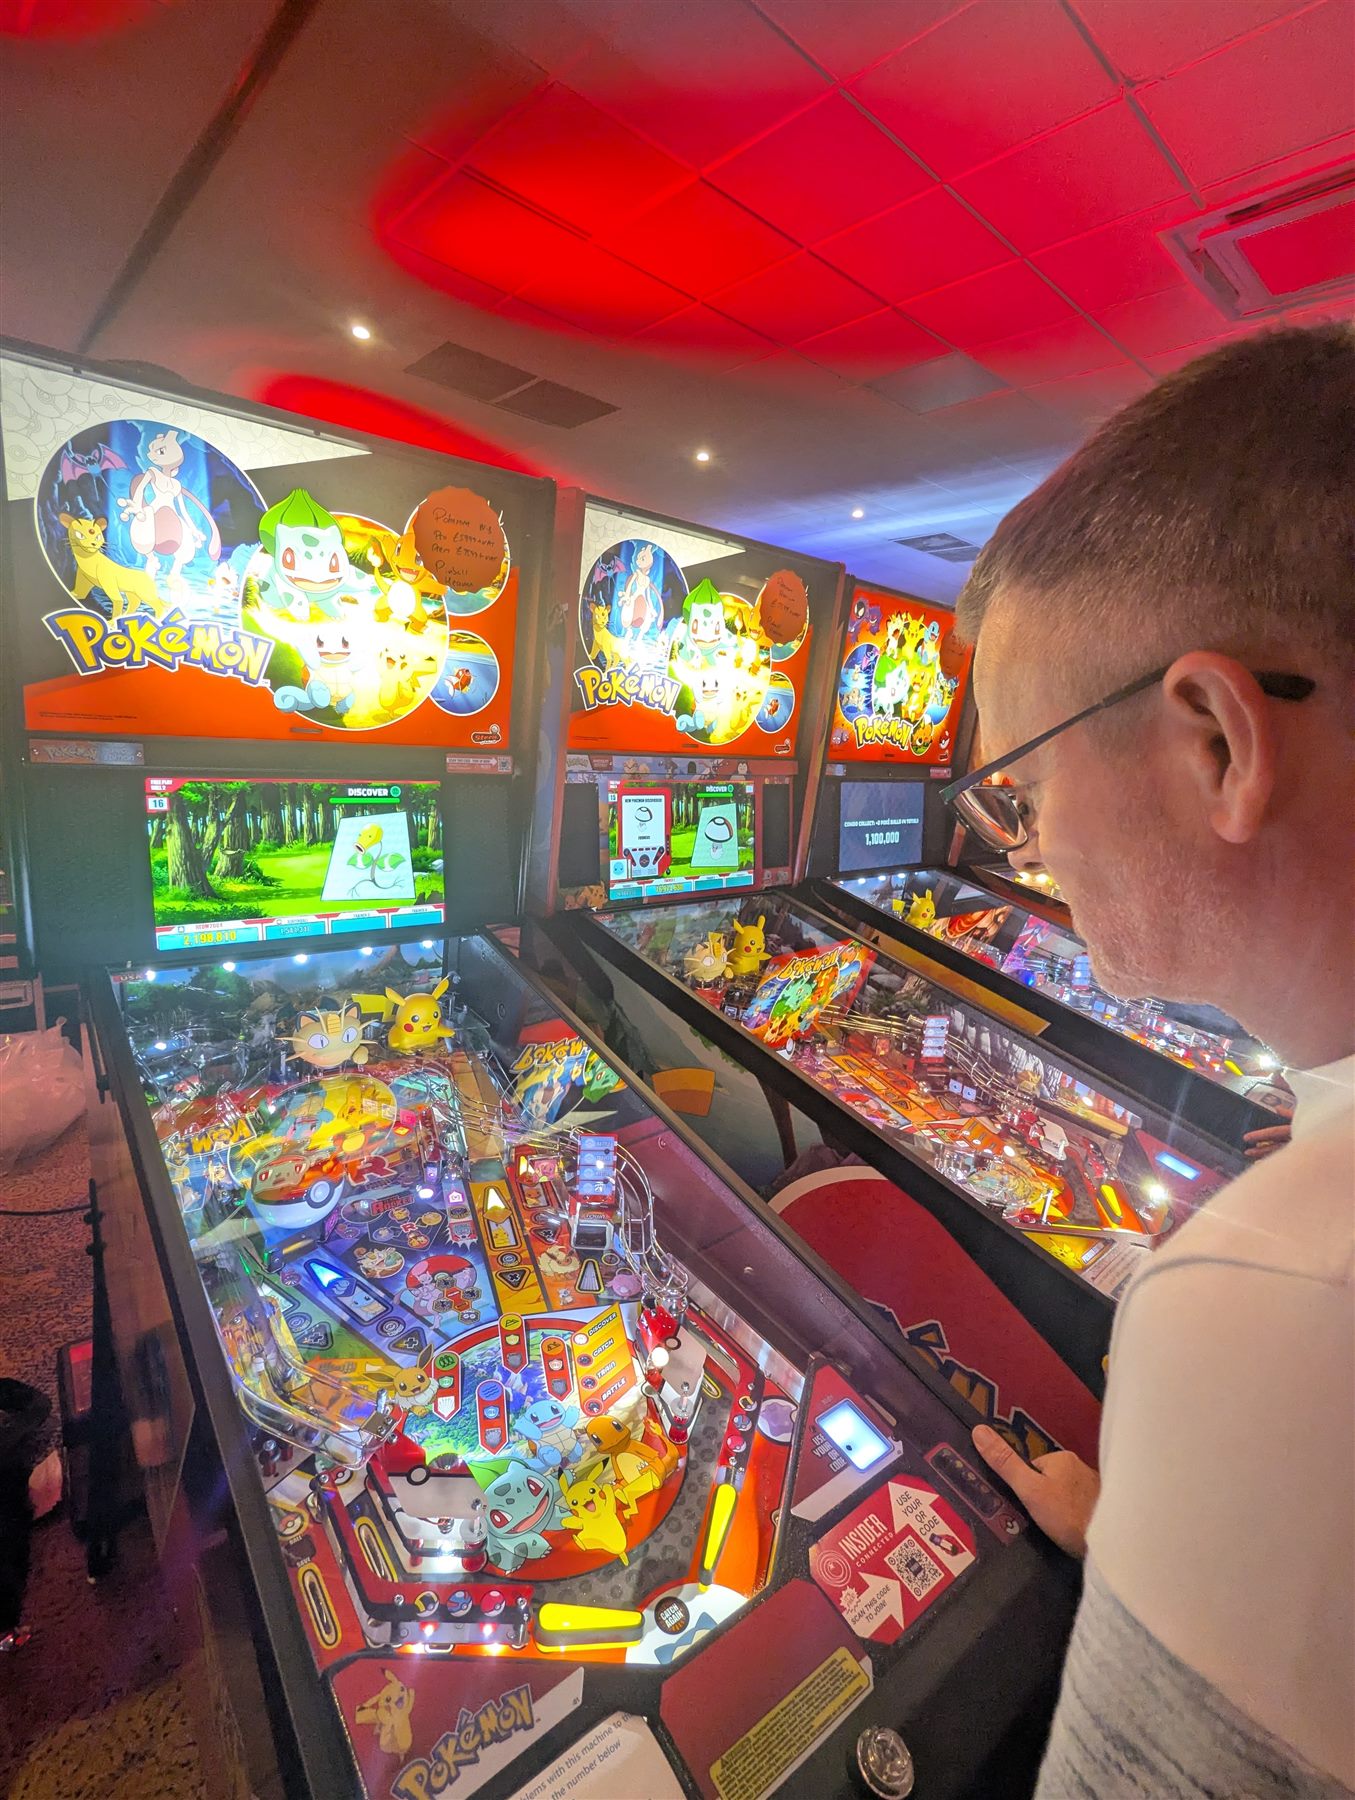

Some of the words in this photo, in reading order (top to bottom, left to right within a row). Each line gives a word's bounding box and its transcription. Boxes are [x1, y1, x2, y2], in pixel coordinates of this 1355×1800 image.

[44, 607, 273, 686] Pokémon
[575, 664, 681, 714] Pokémon
[854, 713, 912, 750] Pokémon
[348, 787, 389, 797] DISCOVER
[152, 799, 164, 808] 16
[865, 831, 899, 846] 1,100,000
[588, 1312, 617, 1336] DISCOVER
[593, 1338, 614, 1357] CATCH
[596, 1361, 616, 1378] TRAIN
[601, 1377, 626, 1401] BATTLE
[811, 1433, 826, 1446] USE
[812, 1441, 833, 1457] YOUR
[827, 1449, 840, 1460] QR
[829, 1456, 847, 1472] CODE
[895, 1490, 912, 1507] USE
[901, 1498, 923, 1517] YOUR
[914, 1510, 927, 1524] QR
[919, 1515, 940, 1537] CODE
[838, 1513, 888, 1560] INSIDER
[856, 1532, 894, 1567] CONNECTED
[660, 1603, 679, 1620] CATCH
[851, 1607, 866, 1625] SCAN
[865, 1596, 877, 1614] THIS
[876, 1585, 891, 1600] CODE
[865, 1612, 874, 1623] TO
[873, 1600, 888, 1616] JOIN!
[665, 1610, 684, 1628] AGAIN
[547, 1764, 566, 1784] with
[565, 1752, 582, 1769] this
[582, 1726, 614, 1756] machine
[612, 1720, 622, 1731] to
[551, 1786, 567, 1800] the
[567, 1759, 601, 1789] number
[598, 1738, 622, 1763] below
